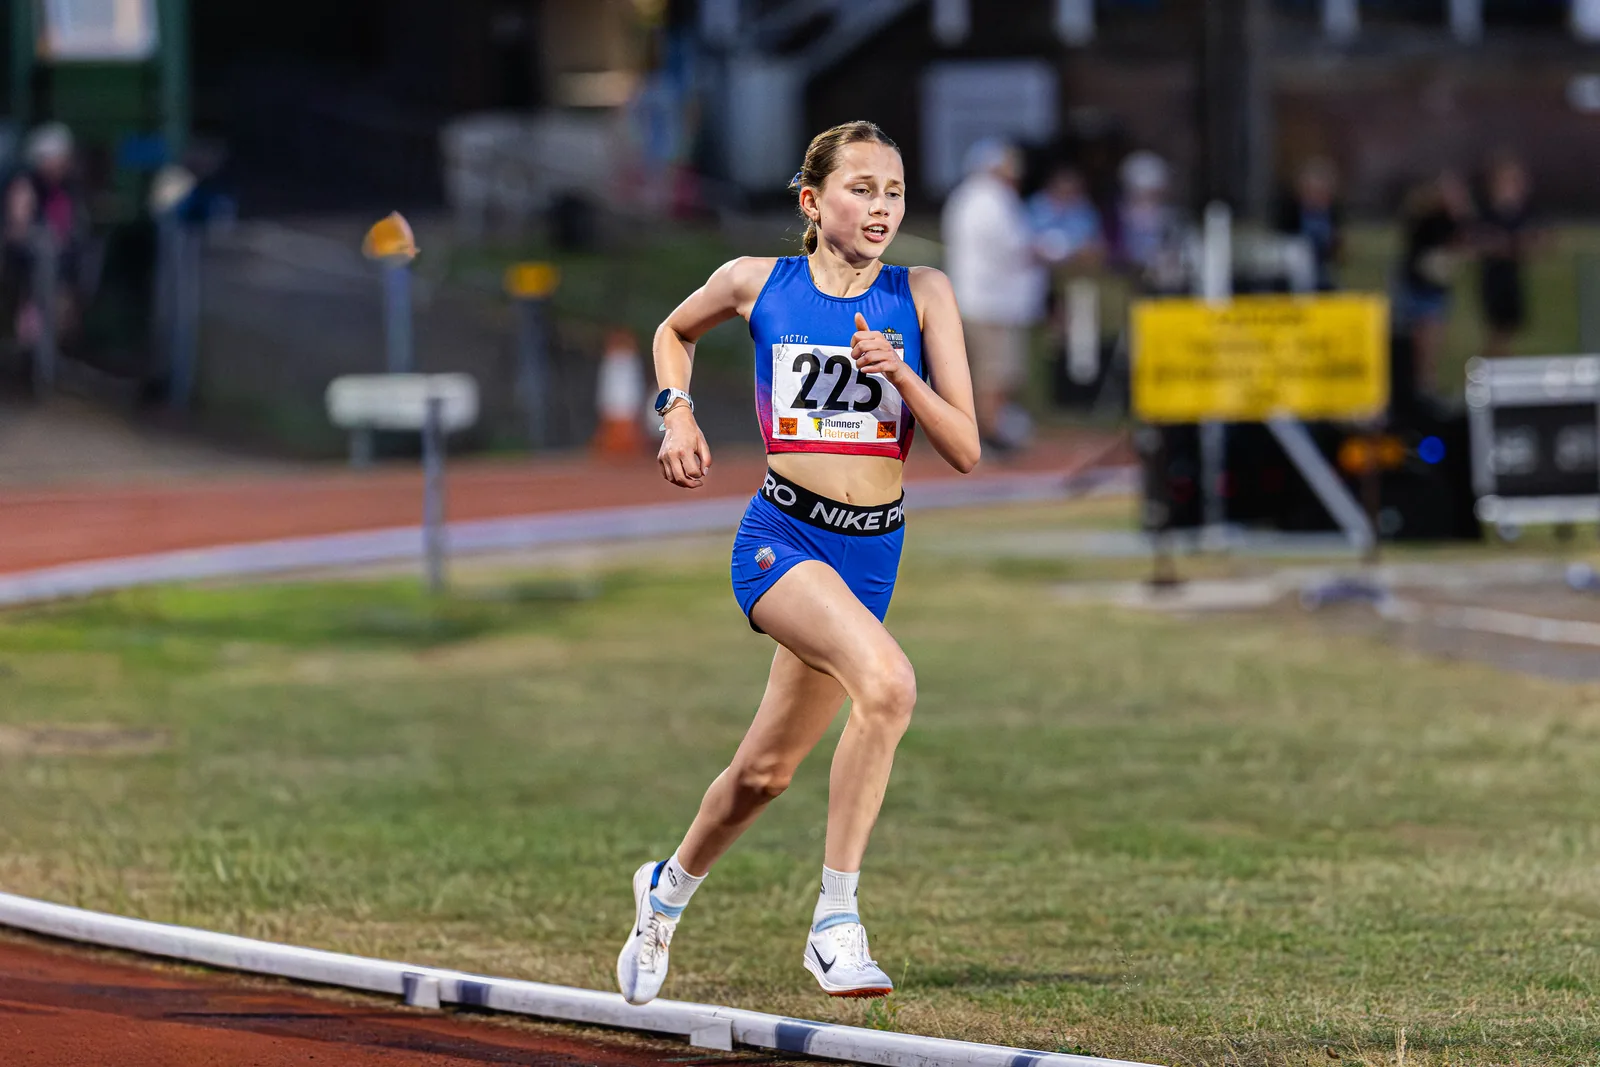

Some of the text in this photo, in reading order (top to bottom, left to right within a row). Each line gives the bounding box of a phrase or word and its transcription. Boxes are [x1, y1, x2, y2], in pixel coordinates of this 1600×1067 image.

[780, 334, 809, 345] TACTIC
[790, 353, 882, 412] 225
[825, 418, 863, 429] Runners'
[824, 429, 860, 439] Retreat
[809, 501, 883, 530] NIKE
